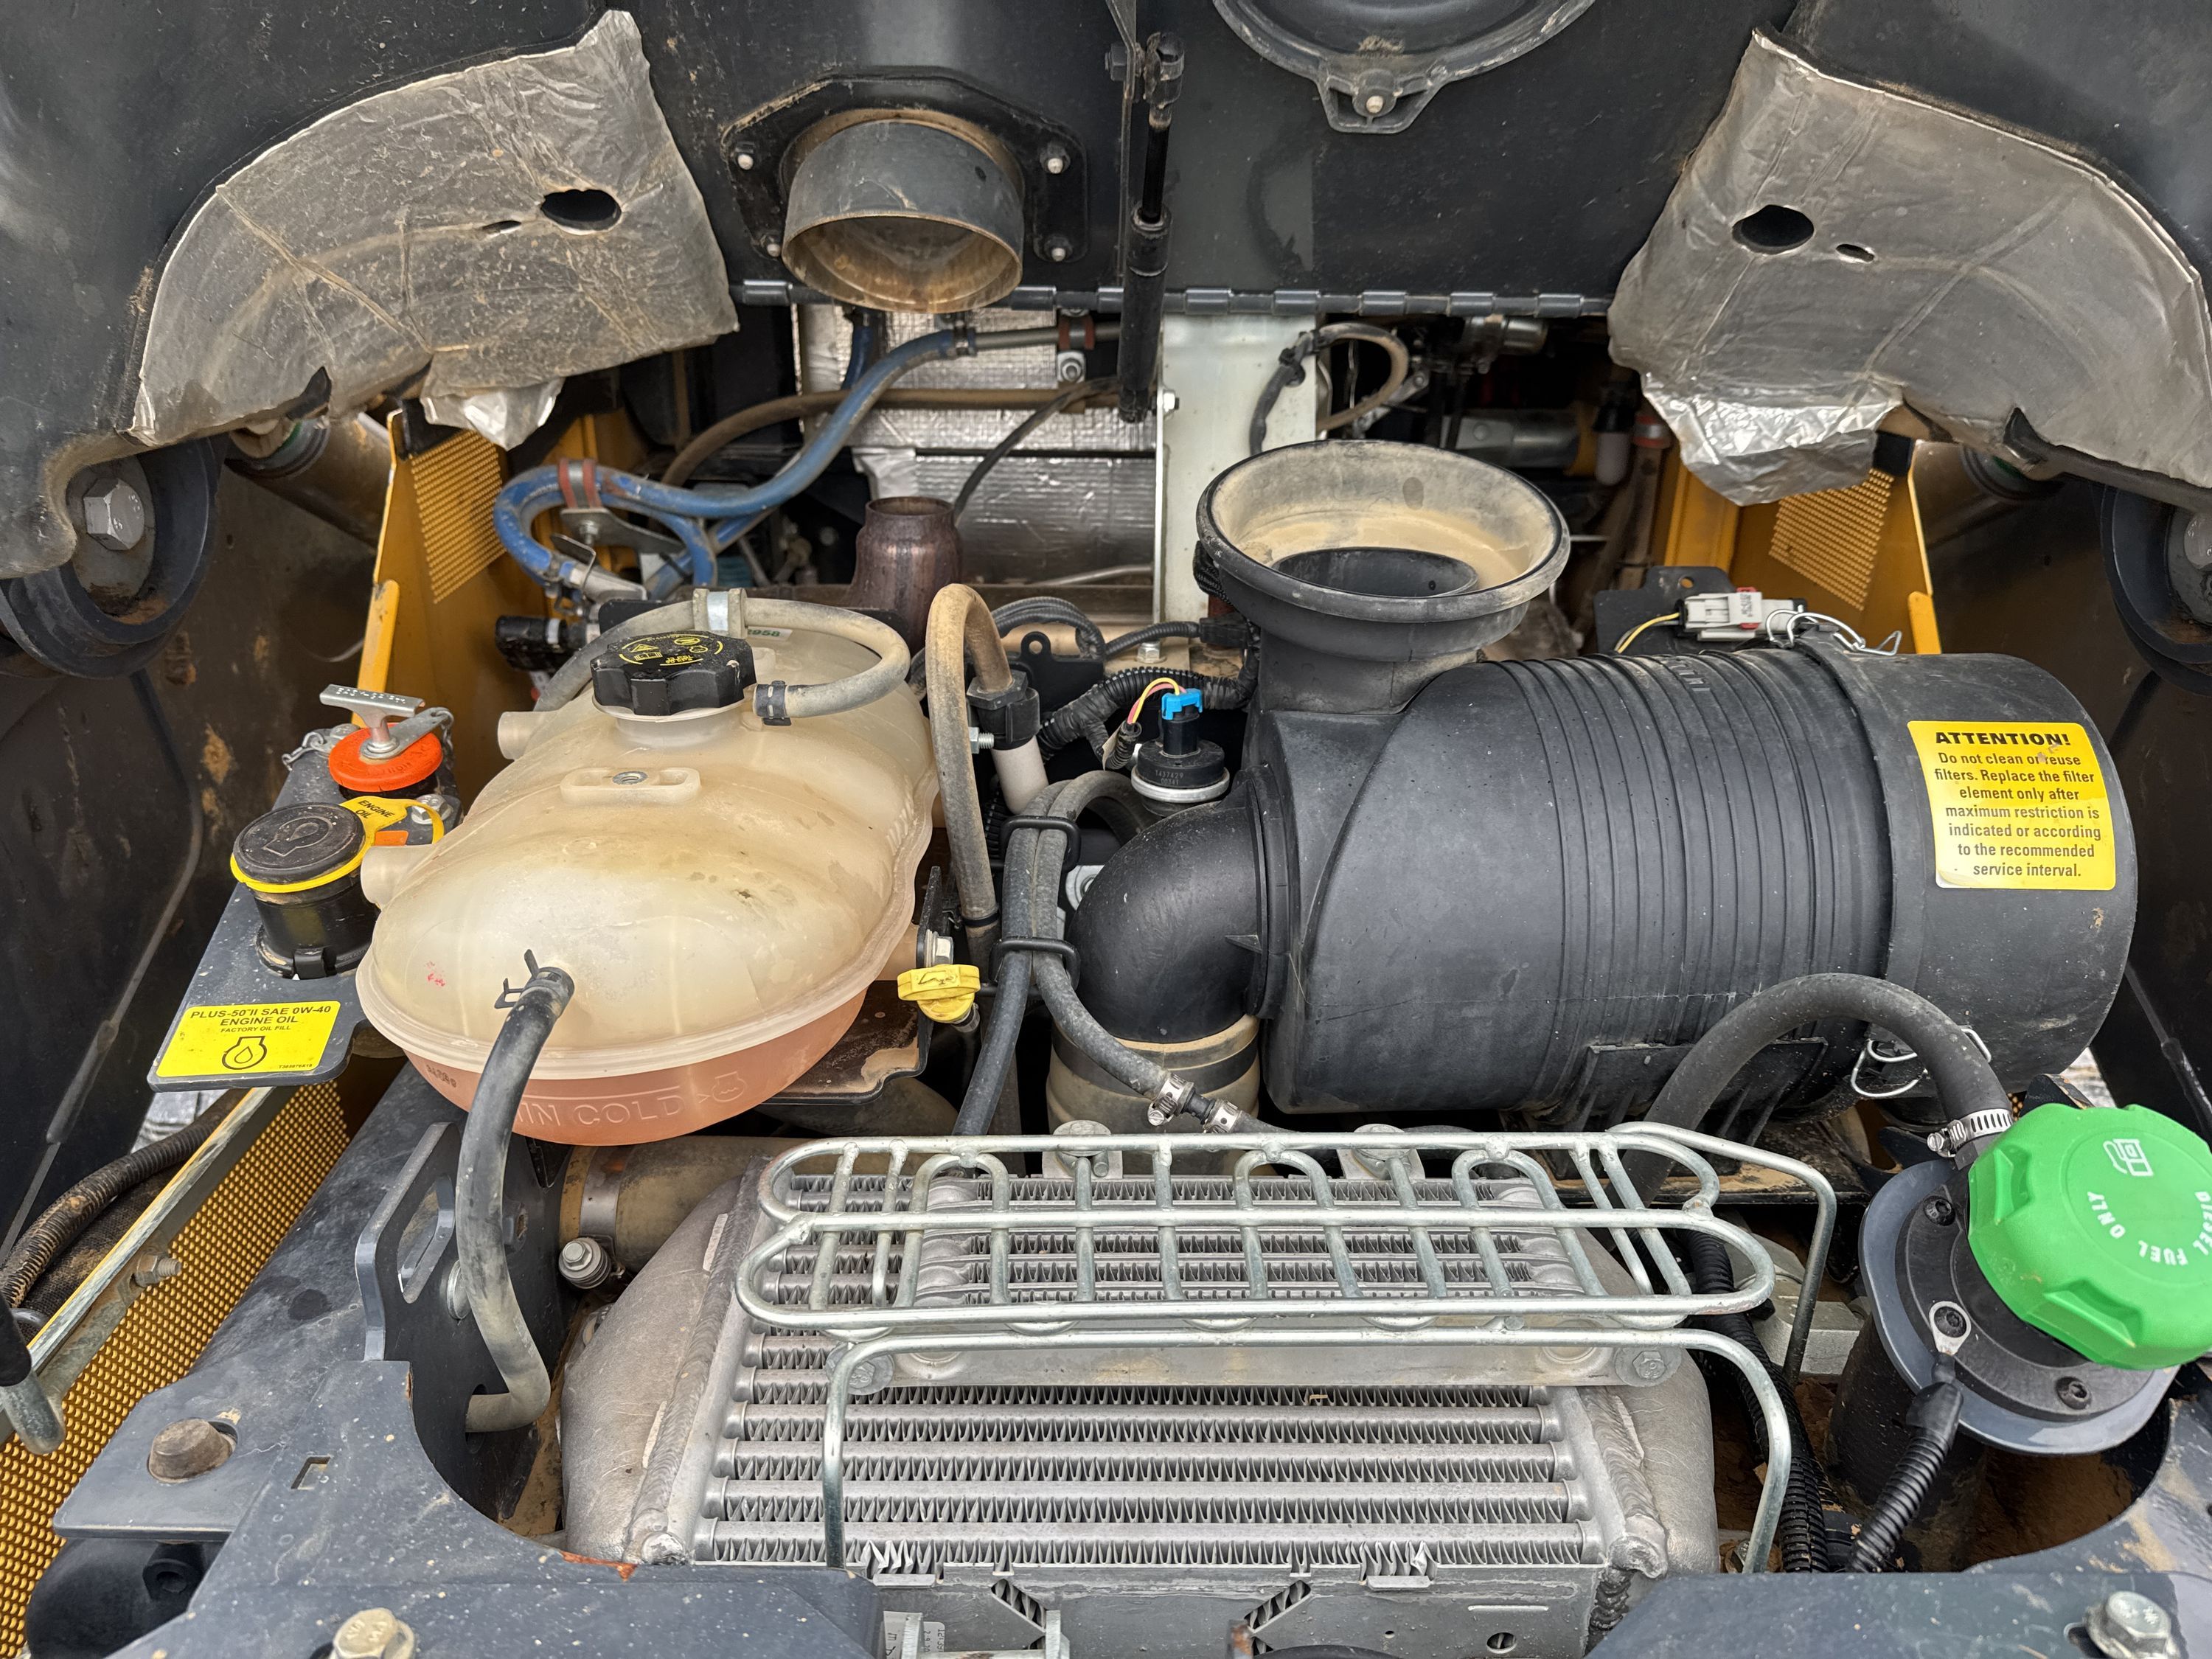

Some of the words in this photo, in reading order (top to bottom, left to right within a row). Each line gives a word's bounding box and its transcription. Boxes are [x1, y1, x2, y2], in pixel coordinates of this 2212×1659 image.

[1935, 731, 2071, 745] ATTENTION!
[1938, 752, 1957, 764] Do
[1961, 753, 1982, 765] not
[1986, 753, 2023, 765] clean
[2027, 756, 2039, 765] or
[2045, 755, 2081, 765] reuse
[1934, 769, 1978, 781] filters.
[1981, 769, 2035, 784] Replace
[2038, 771, 2060, 782] the
[2062, 771, 2095, 782] filter
[1959, 788, 2013, 800] element
[2017, 788, 2045, 802] only
[2048, 788, 2080, 800] after
[355, 809, 372, 819] OIL
[358, 799, 396, 818] ENGINE
[1945, 805, 2011, 818] maximum
[2014, 806, 2084, 818] restriction
[2087, 807, 2100, 819] is
[1949, 823, 2012, 837] indicated
[2017, 827, 2030, 838] or
[2034, 825, 2101, 841] according
[1958, 844, 1970, 855] to
[1975, 843, 1996, 856] the
[2000, 844, 2095, 858] recommended
[1973, 863, 2023, 876] service
[2026, 863, 2081, 877] interval.
[260, 1007, 290, 1016] SAE
[292, 1005, 332, 1015] 0W-40
[220, 1017, 274, 1026] ENGINE
[276, 1015, 298, 1023] OIL
[573, 1094, 685, 1125] COLD
[2087, 1191, 2126, 1239] ONLY
[2138, 1239, 2188, 1266] FUEL
